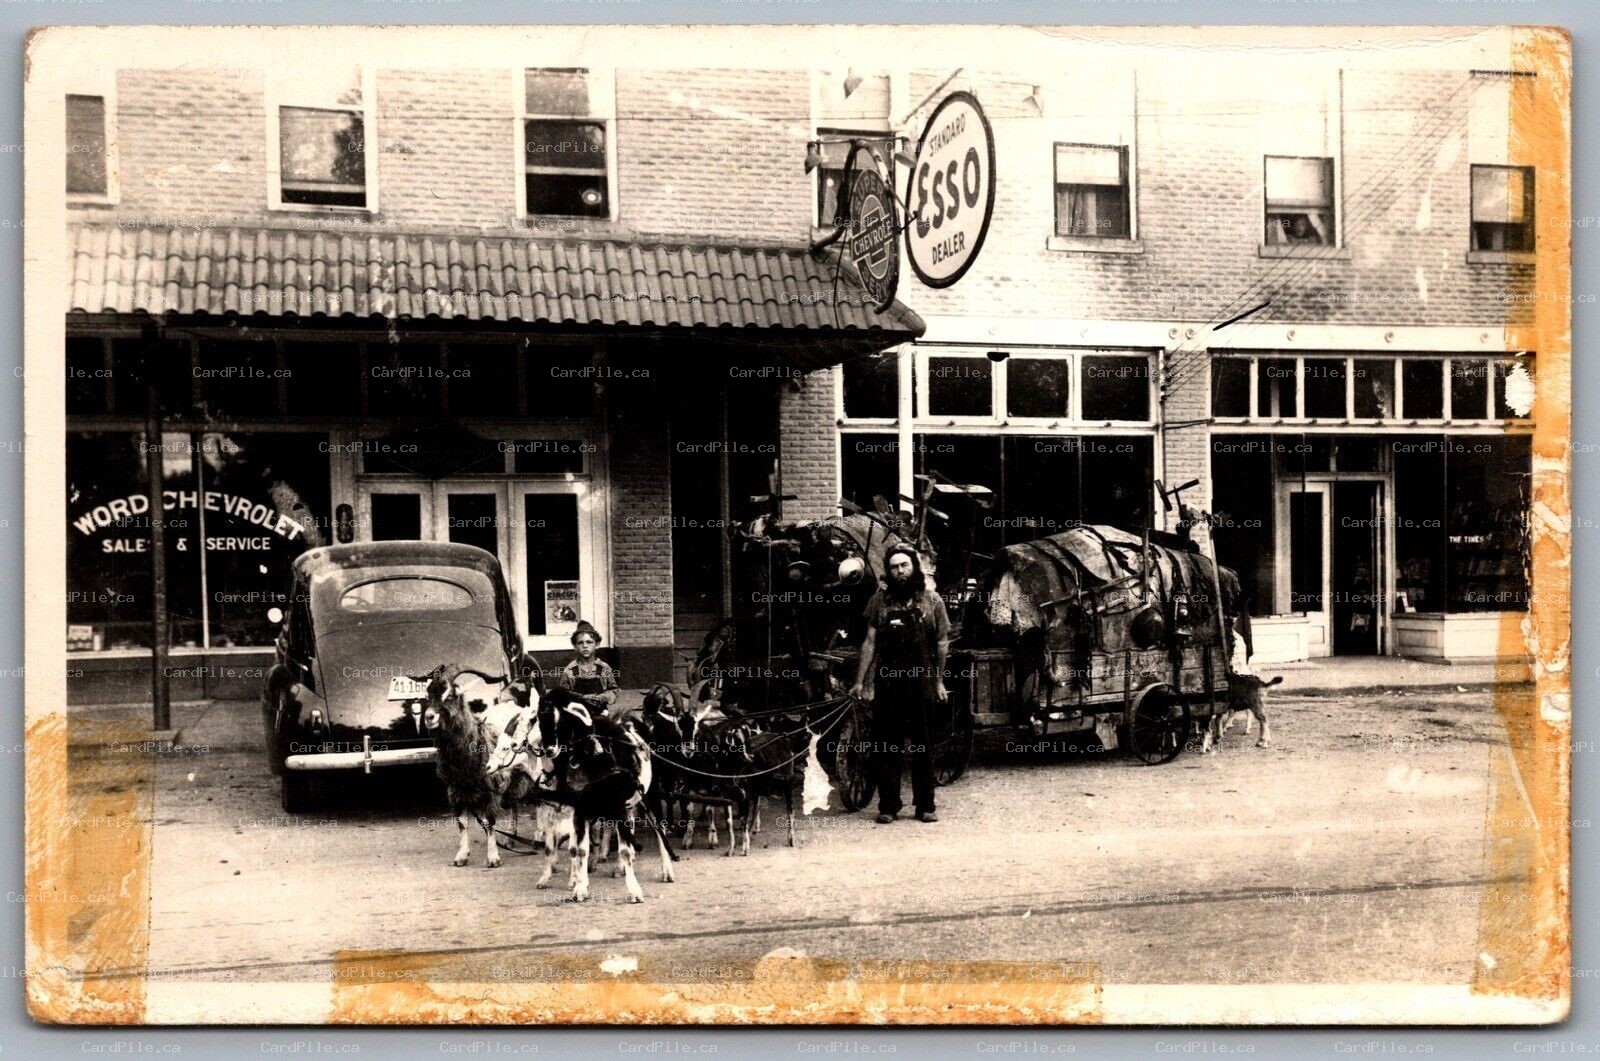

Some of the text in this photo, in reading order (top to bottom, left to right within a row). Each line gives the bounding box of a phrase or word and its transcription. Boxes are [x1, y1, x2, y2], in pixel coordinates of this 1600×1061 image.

[929, 112, 967, 157] STANDARD
[916, 146, 981, 239] ESSO
[853, 220, 893, 256] CHEVROLE
[932, 231, 966, 266] DEALER
[73, 490, 306, 542] WORD CHEVROLET
[102, 537, 272, 554] SALE & SERVICE
